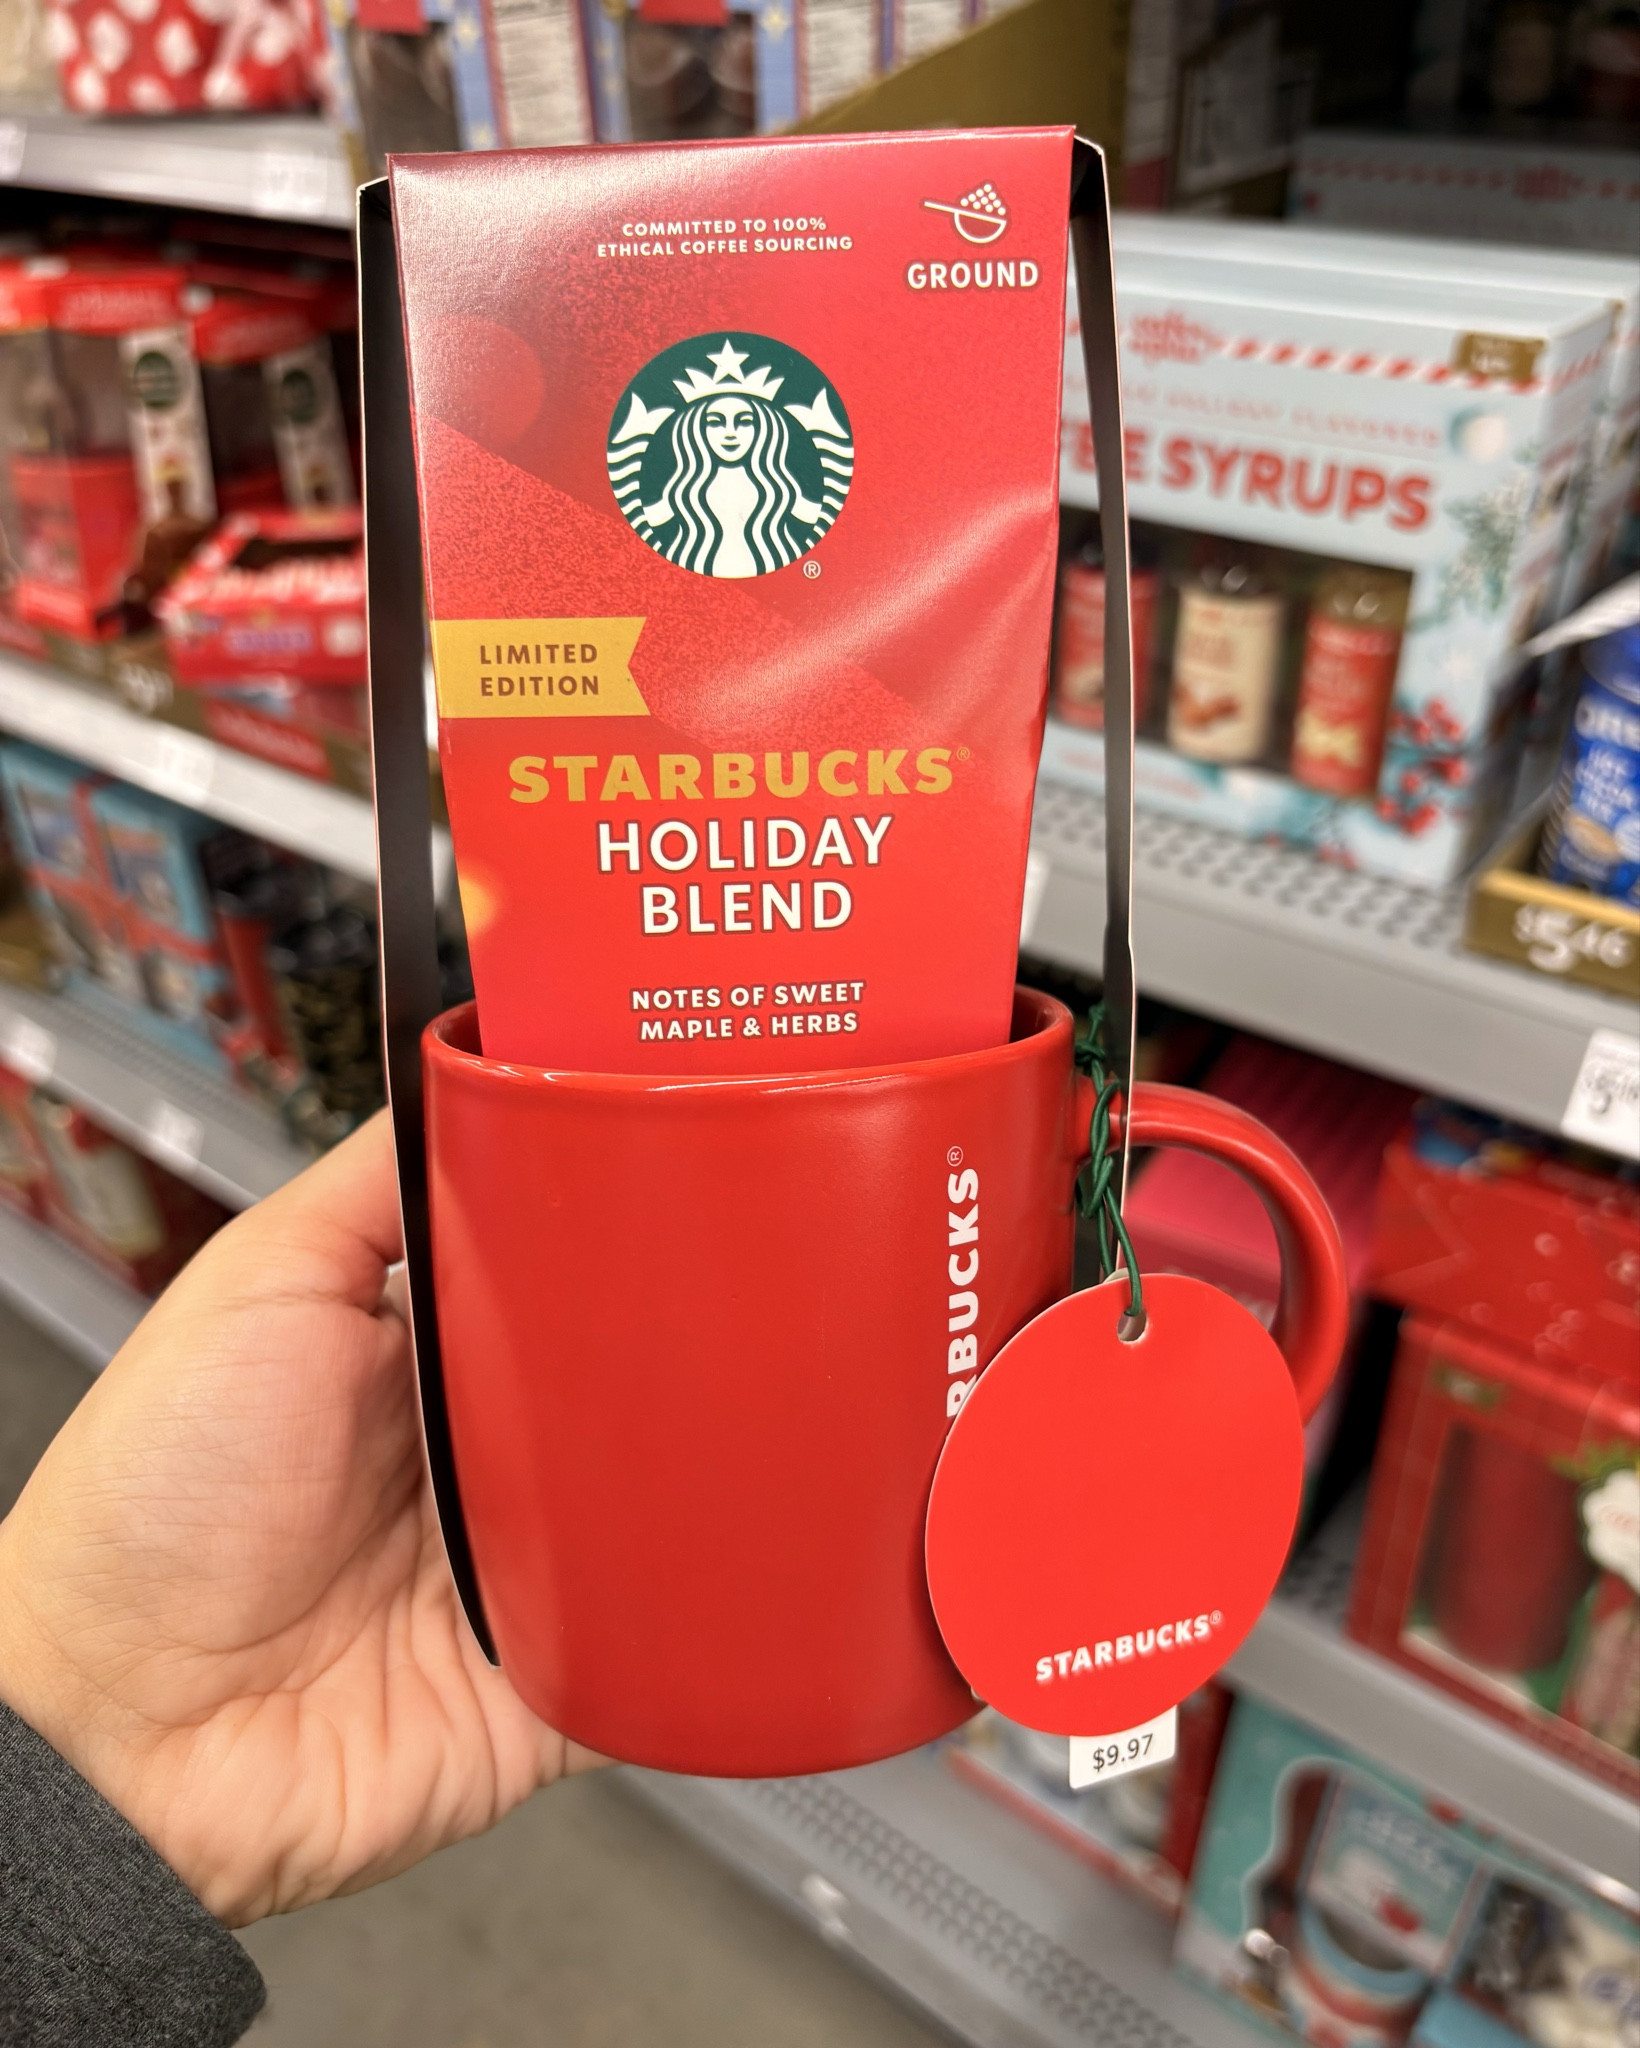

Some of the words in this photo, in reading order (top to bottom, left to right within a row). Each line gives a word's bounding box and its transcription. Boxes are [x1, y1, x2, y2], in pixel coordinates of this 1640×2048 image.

[621, 219, 737, 237] COMMITTED
[742, 218, 767, 233] TO
[773, 217, 827, 233] 100%
[597, 241, 675, 258] ETHICAL
[680, 239, 748, 256] COFFEE
[754, 236, 853, 253] SOURCING
[907, 261, 1039, 290] GROUND
[1161, 434, 1432, 532] SYRUPS
[479, 643, 598, 665] LIMITED
[481, 676, 598, 696] EDITION
[598, 815, 893, 873] HOLIDAY
[642, 881, 853, 935] BLEND
[632, 988, 721, 1010] NOTES
[730, 986, 765, 1007] OF
[774, 982, 864, 1005] SWEET
[641, 1018, 733, 1040] MAPLE
[742, 1017, 761, 1037] &
[772, 1012, 857, 1035] HERBS
[1092, 1733, 1154, 1774] $9.97
